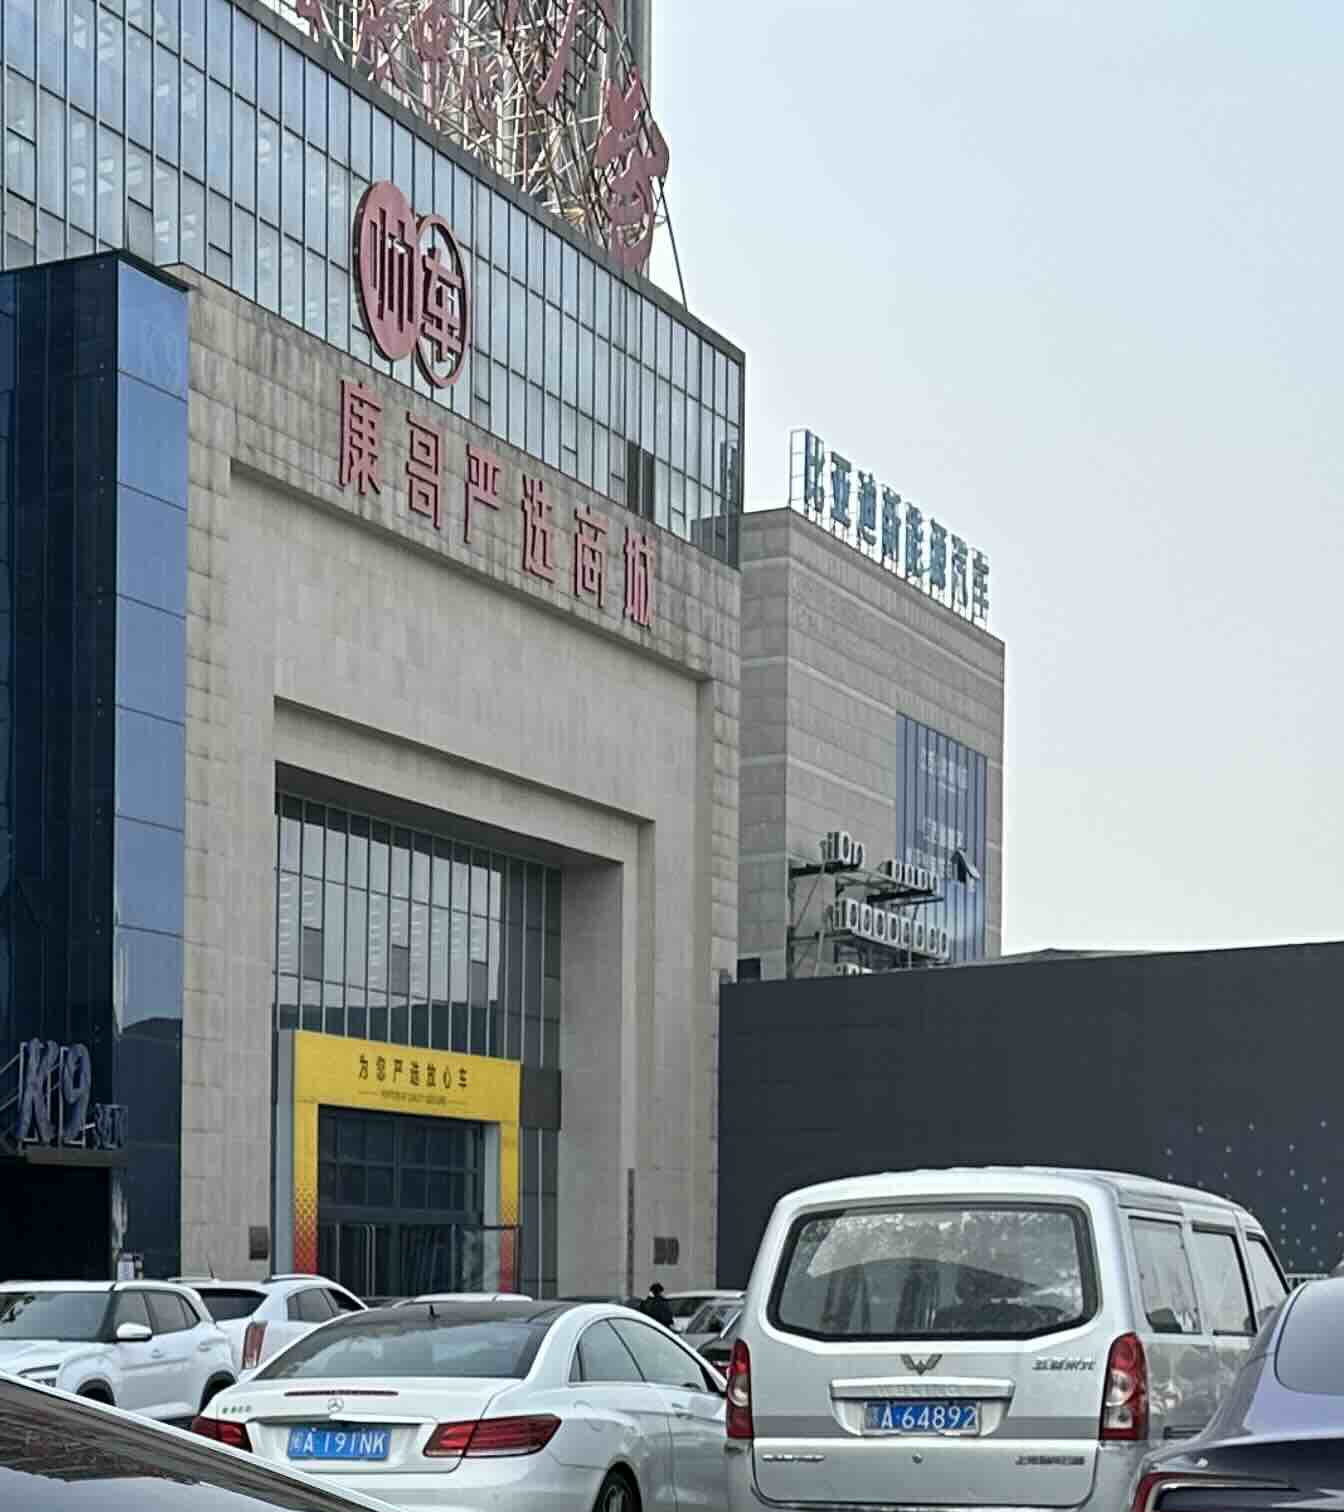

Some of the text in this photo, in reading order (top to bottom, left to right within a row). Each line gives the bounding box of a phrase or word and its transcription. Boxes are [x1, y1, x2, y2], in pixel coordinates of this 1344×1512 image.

[337, 379, 657, 631] 康哥严选商城
